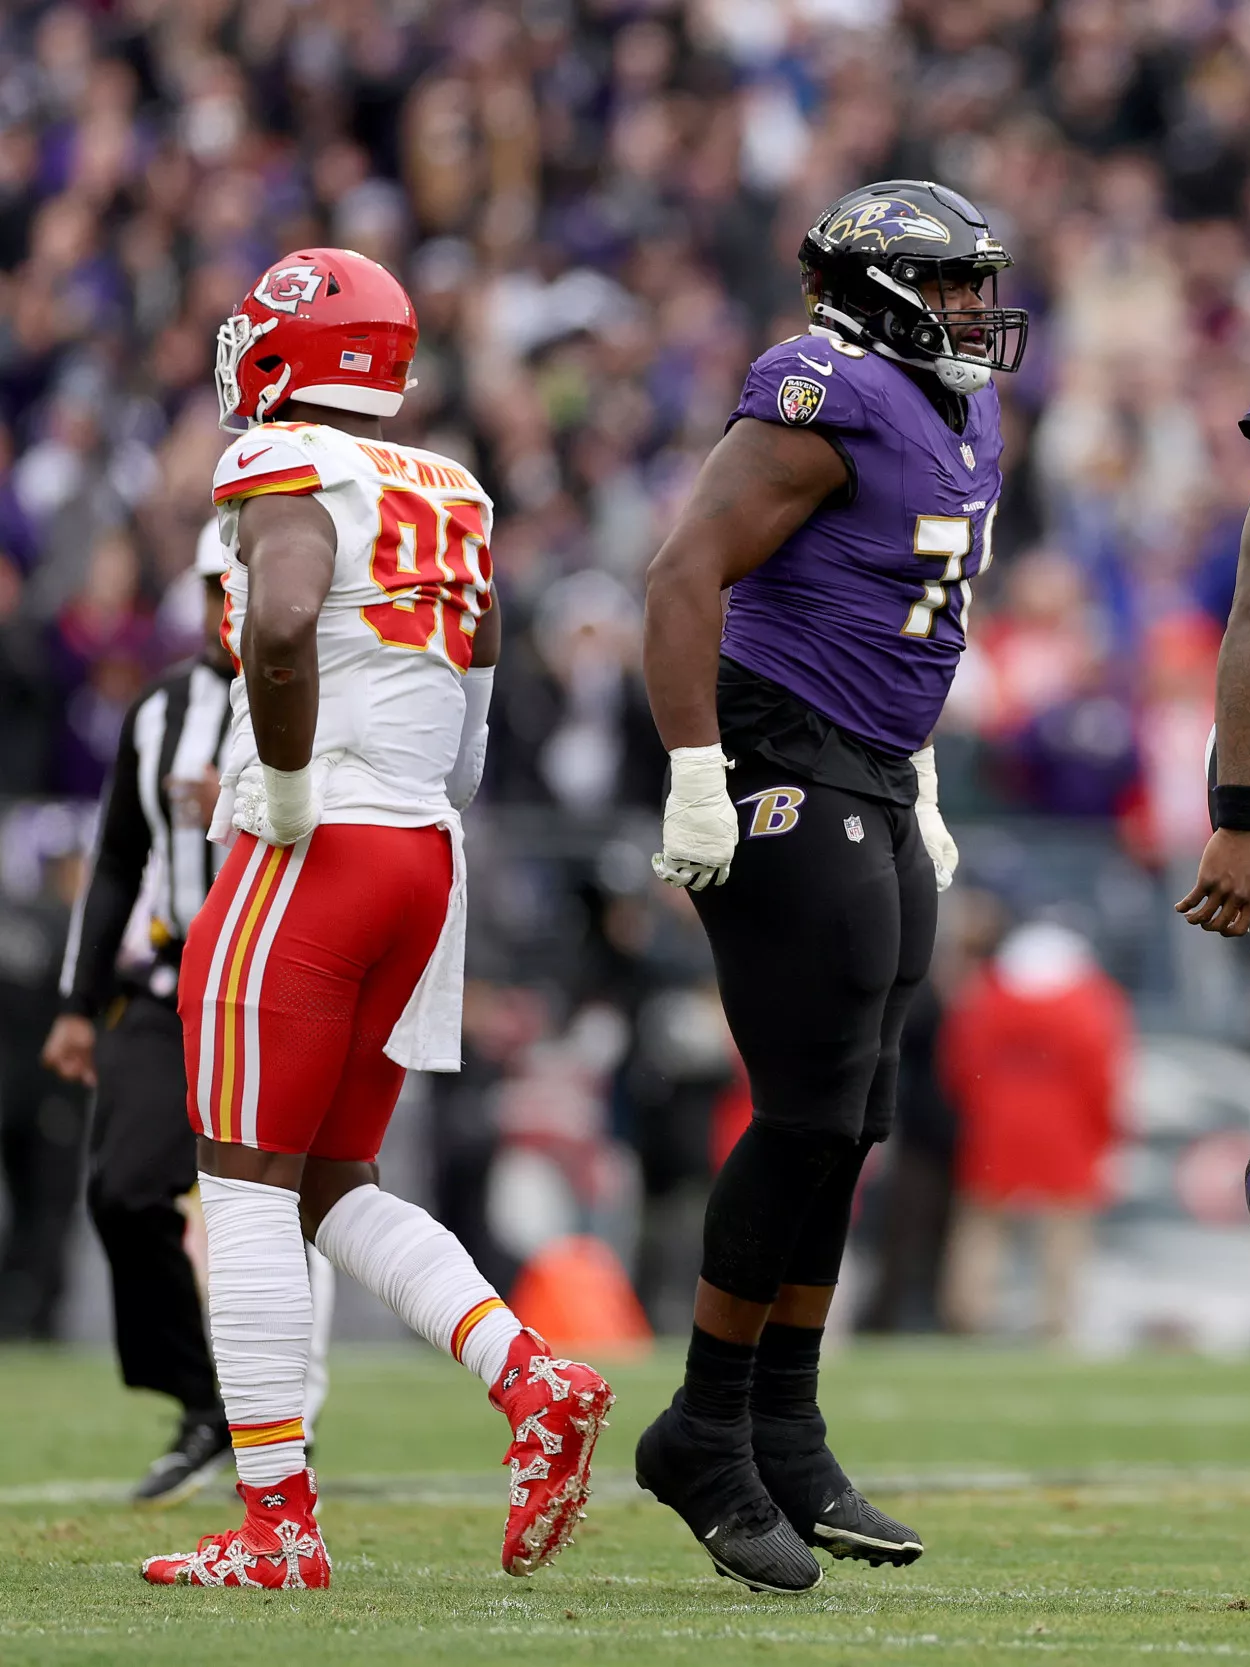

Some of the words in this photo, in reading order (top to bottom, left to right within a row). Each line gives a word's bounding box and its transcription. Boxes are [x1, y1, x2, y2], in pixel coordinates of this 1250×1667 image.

[852, 201, 892, 228] B
[262, 273, 309, 302] KC
[787, 380, 820, 395] RAVENS
[962, 500, 986, 513] RAVENS
[360, 486, 494, 676] 90
[735, 785, 806, 838] B
[848, 827, 861, 838] NFL
